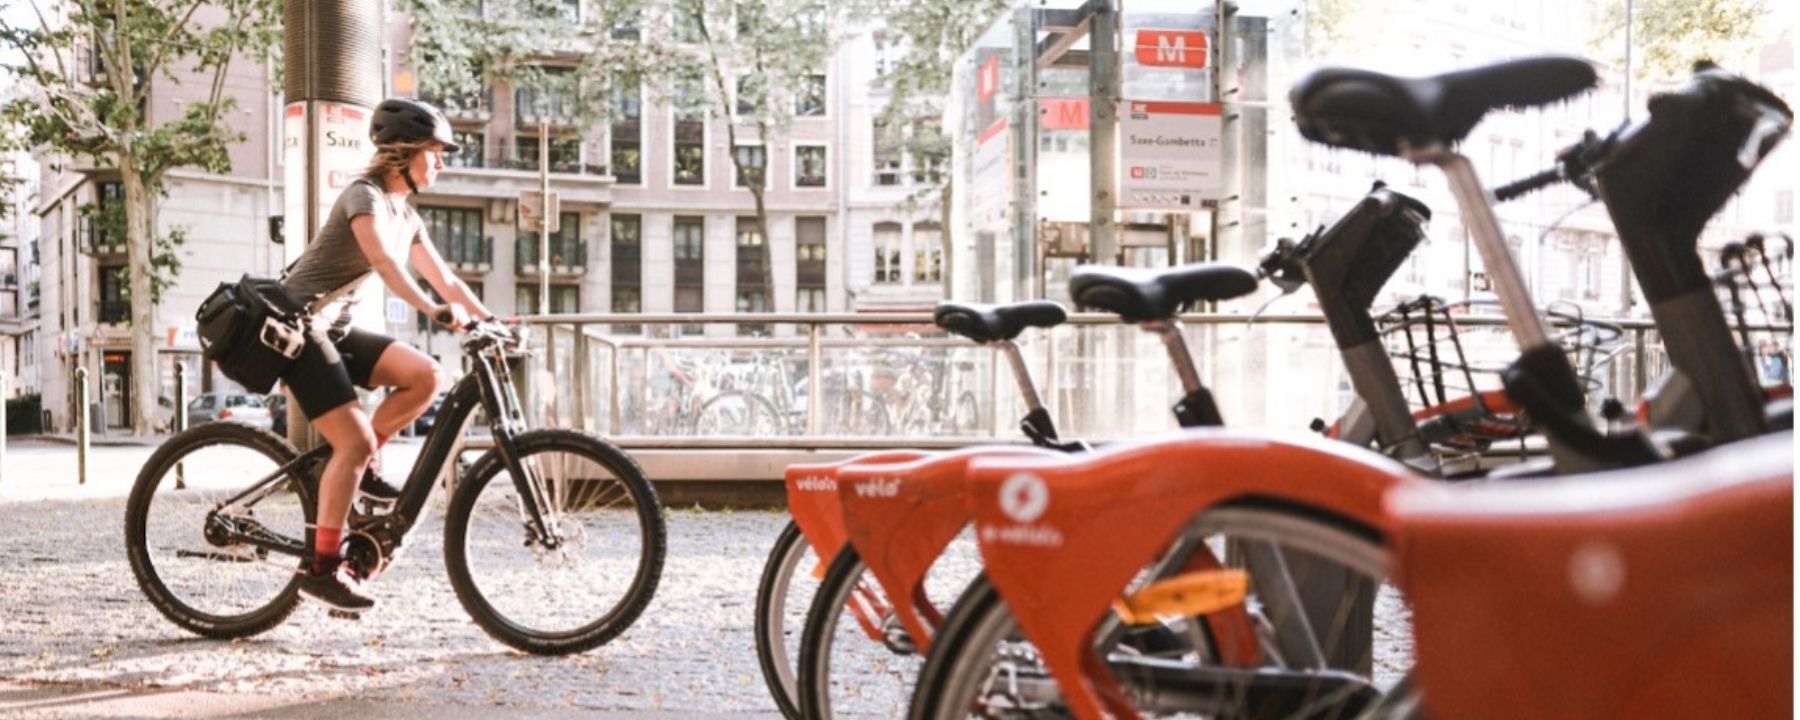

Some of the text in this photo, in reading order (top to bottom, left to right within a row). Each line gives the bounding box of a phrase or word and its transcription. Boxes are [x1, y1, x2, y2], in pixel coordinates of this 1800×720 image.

[1158, 35, 1185, 63] M
[1059, 101, 1083, 125] M
[1130, 135, 1206, 147] Saxe-Gambetta
